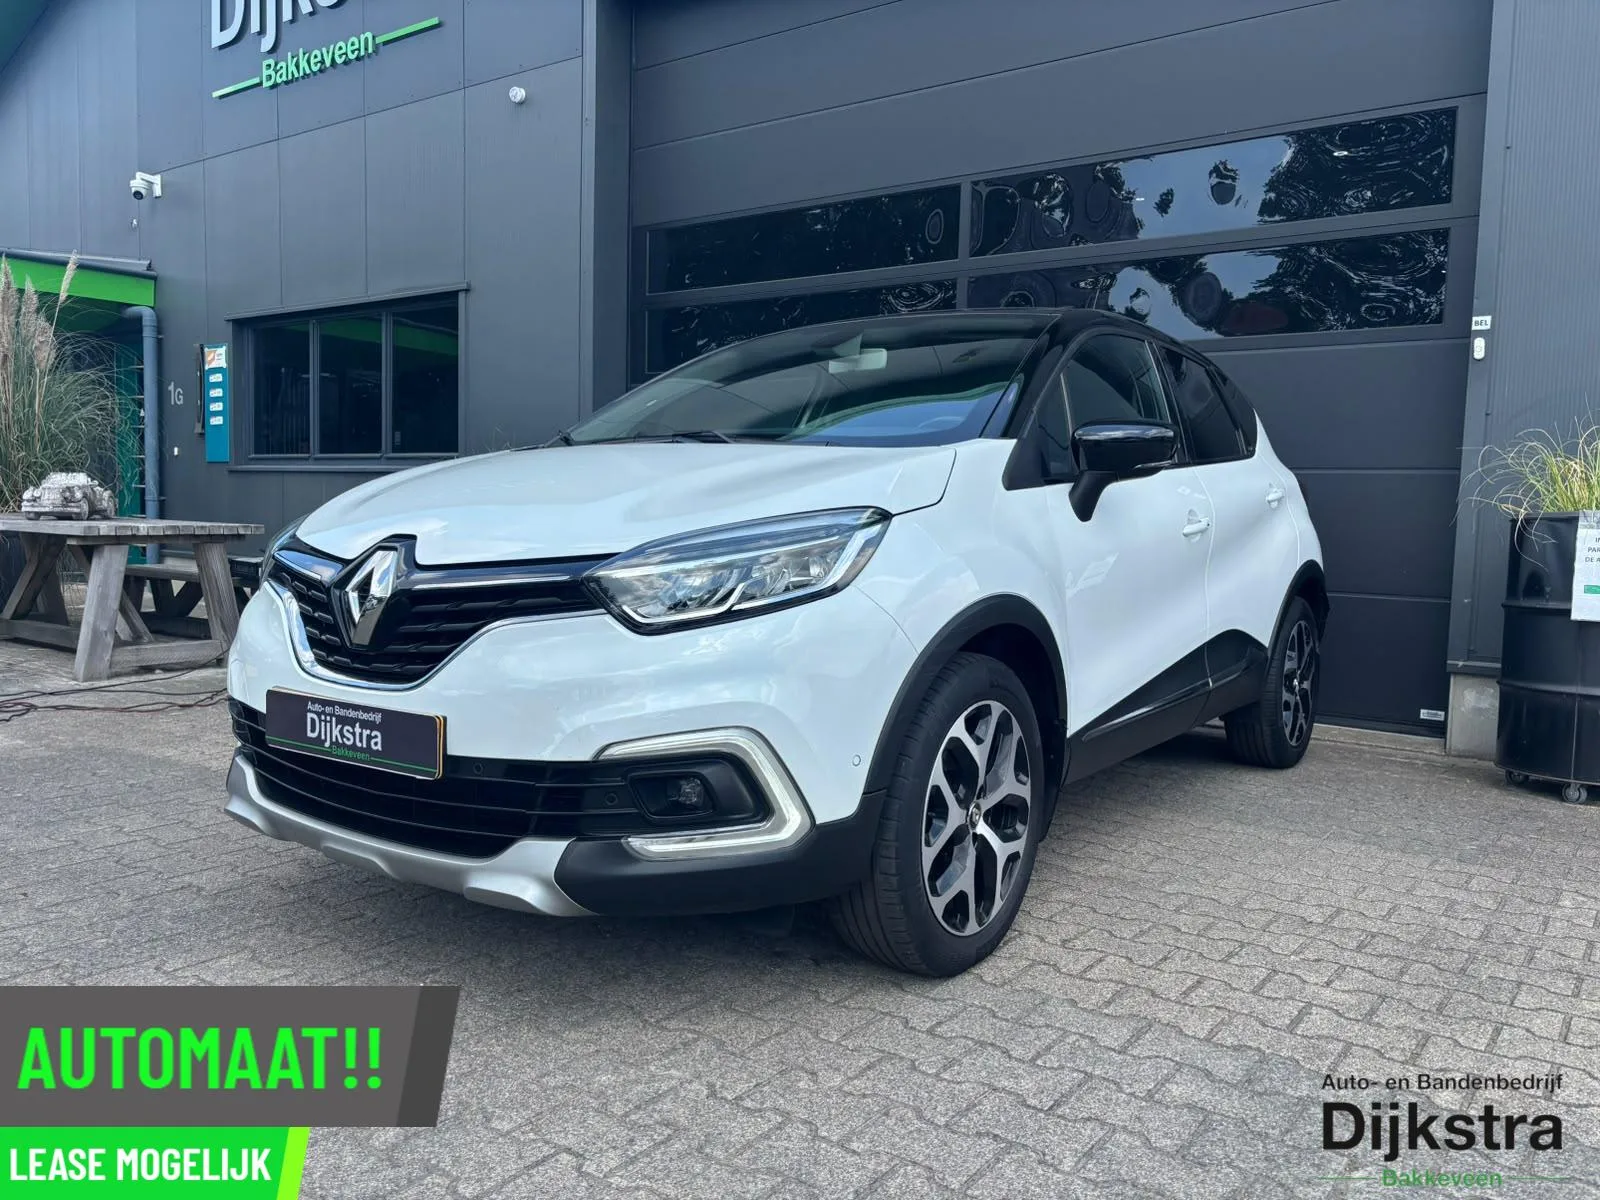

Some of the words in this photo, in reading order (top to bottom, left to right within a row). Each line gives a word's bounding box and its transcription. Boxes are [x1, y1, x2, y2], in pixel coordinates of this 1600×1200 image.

[262, 31, 374, 88] Bakkeveen
[1474, 319, 1488, 327] BEL
[168, 381, 184, 405] 1G
[307, 700, 325, 712] Auto-
[325, 705, 334, 714] en
[334, 705, 382, 725] Bandenbedrijf
[306, 712, 383, 751] Dijkstra
[332, 745, 370, 761] Bakkeveen
